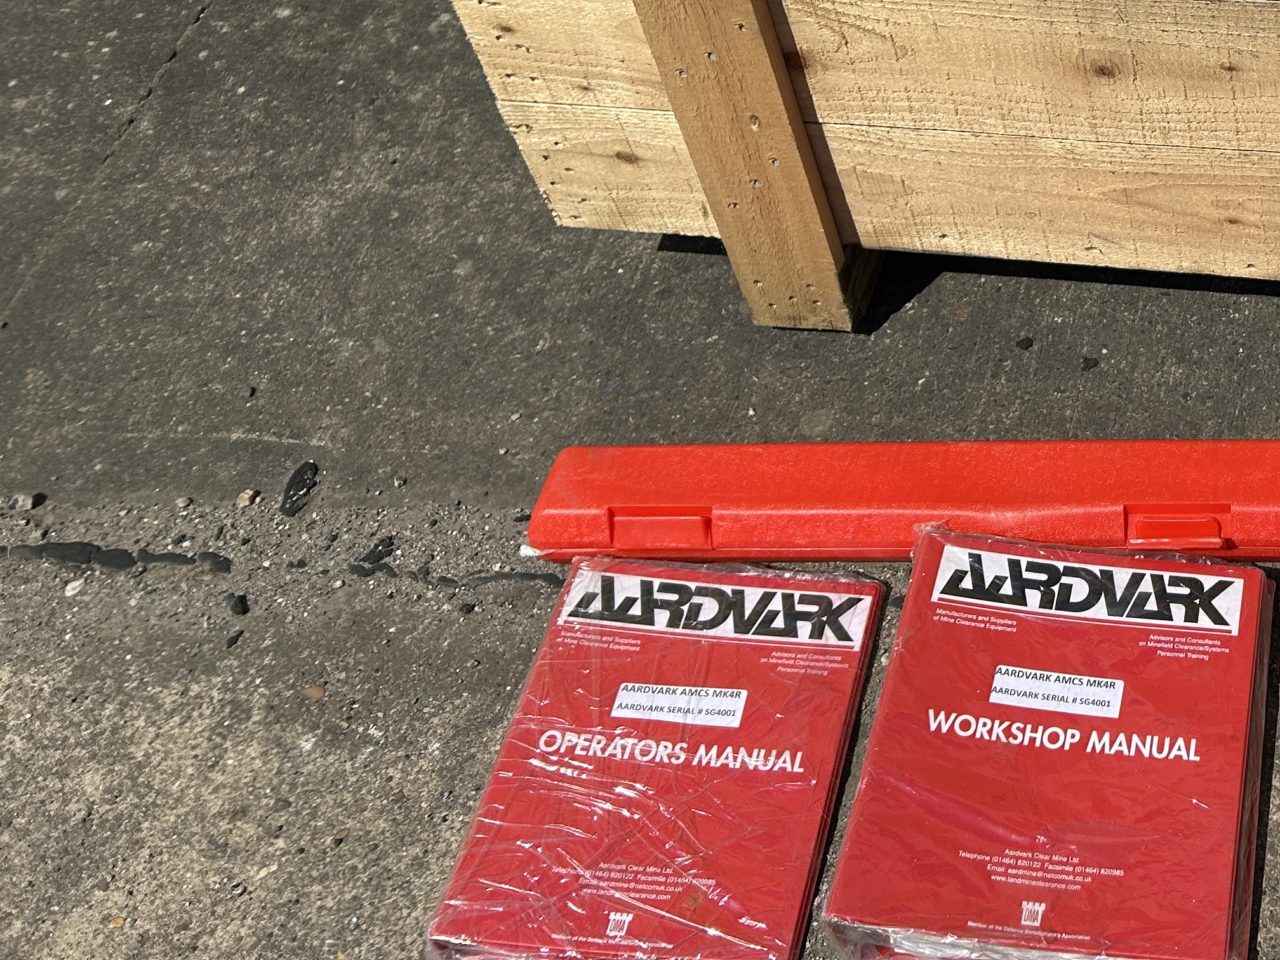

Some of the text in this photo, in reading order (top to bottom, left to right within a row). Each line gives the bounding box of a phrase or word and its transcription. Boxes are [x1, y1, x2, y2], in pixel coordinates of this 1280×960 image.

[939, 552, 1236, 627] AARDVARK
[567, 575, 864, 642] AARDVARK
[936, 608, 977, 620] Manufacturers
[990, 616, 1017, 626] Suppliers
[940, 616, 955, 624] Mine
[956, 618, 985, 628] Clearance
[986, 623, 1017, 632] Equipment
[613, 635, 641, 645] Suppliers
[1147, 640, 1173, 649] Minefield
[1174, 642, 1230, 653] Clearance/Systems
[1149, 634, 1174, 642] Advisors
[1187, 636, 1221, 645] Consultants
[1156, 650, 1209, 661] Personnel Training
[995, 667, 1116, 690] AARDVARK AMCS MK4R
[622, 684, 742, 699] AARDVARK AMCS MK4R
[991, 686, 1039, 700] AARDVARK
[1041, 693, 1070, 703] SERIAL
[1079, 697, 1111, 708] SG4001
[616, 702, 665, 713] AARDVARK
[666, 706, 696, 715] SERIAL
[704, 708, 737, 717] SG4001
[928, 708, 1201, 761] WORKSHOP MANUAL
[538, 730, 804, 773] OPERATORS MANUAL
[958, 850, 991, 862] Telephone
[1017, 859, 1041, 868] 820122
[1004, 848, 1033, 858] Aardvark
[1033, 852, 1050, 860] Clear
[1051, 854, 1068, 862] Mine
